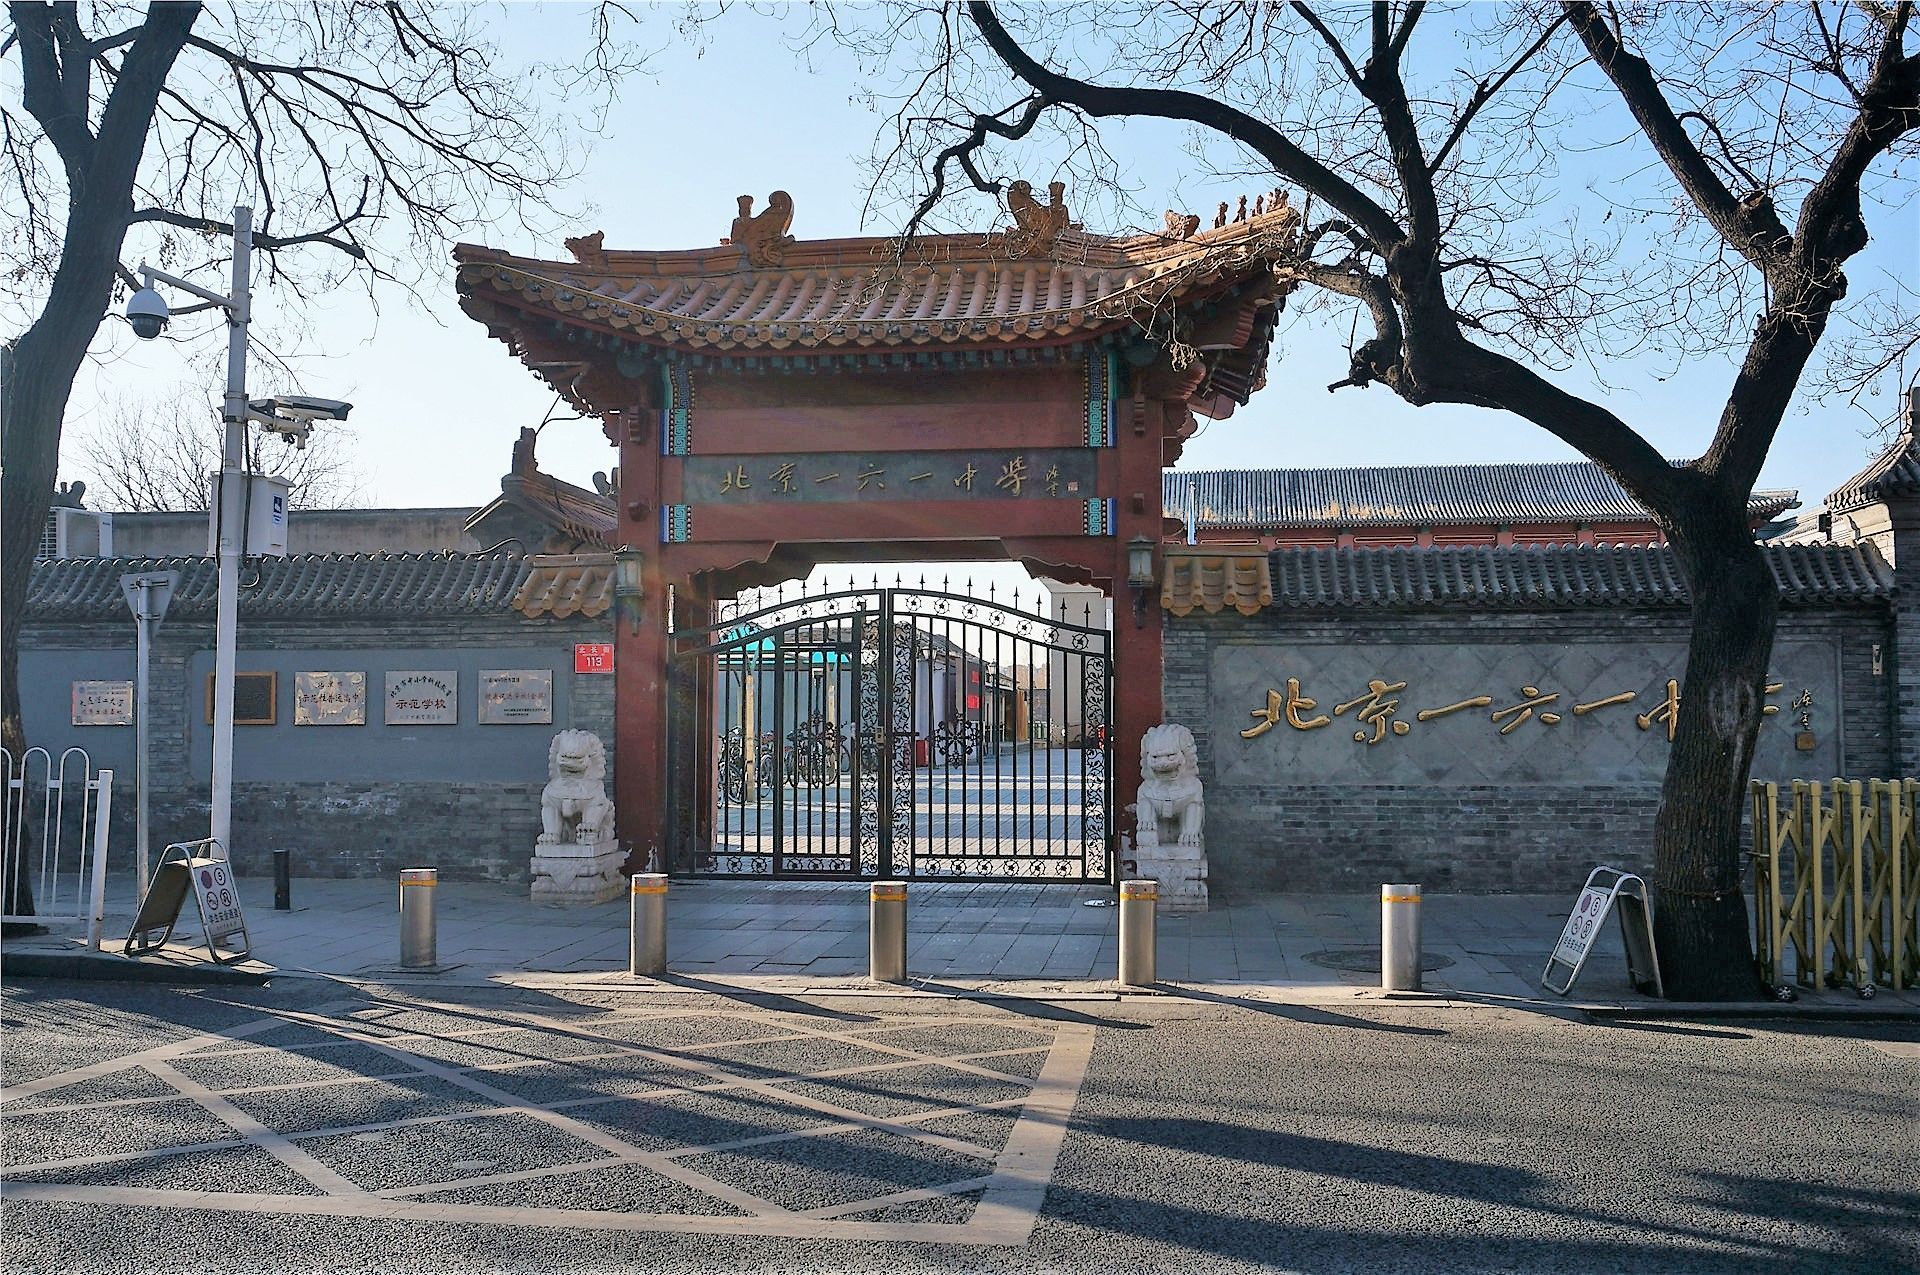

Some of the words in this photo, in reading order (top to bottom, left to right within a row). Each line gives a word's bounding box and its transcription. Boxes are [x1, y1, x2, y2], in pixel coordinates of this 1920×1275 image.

[586, 657, 602, 667] 113
[395, 699, 446, 710] 示范学校
